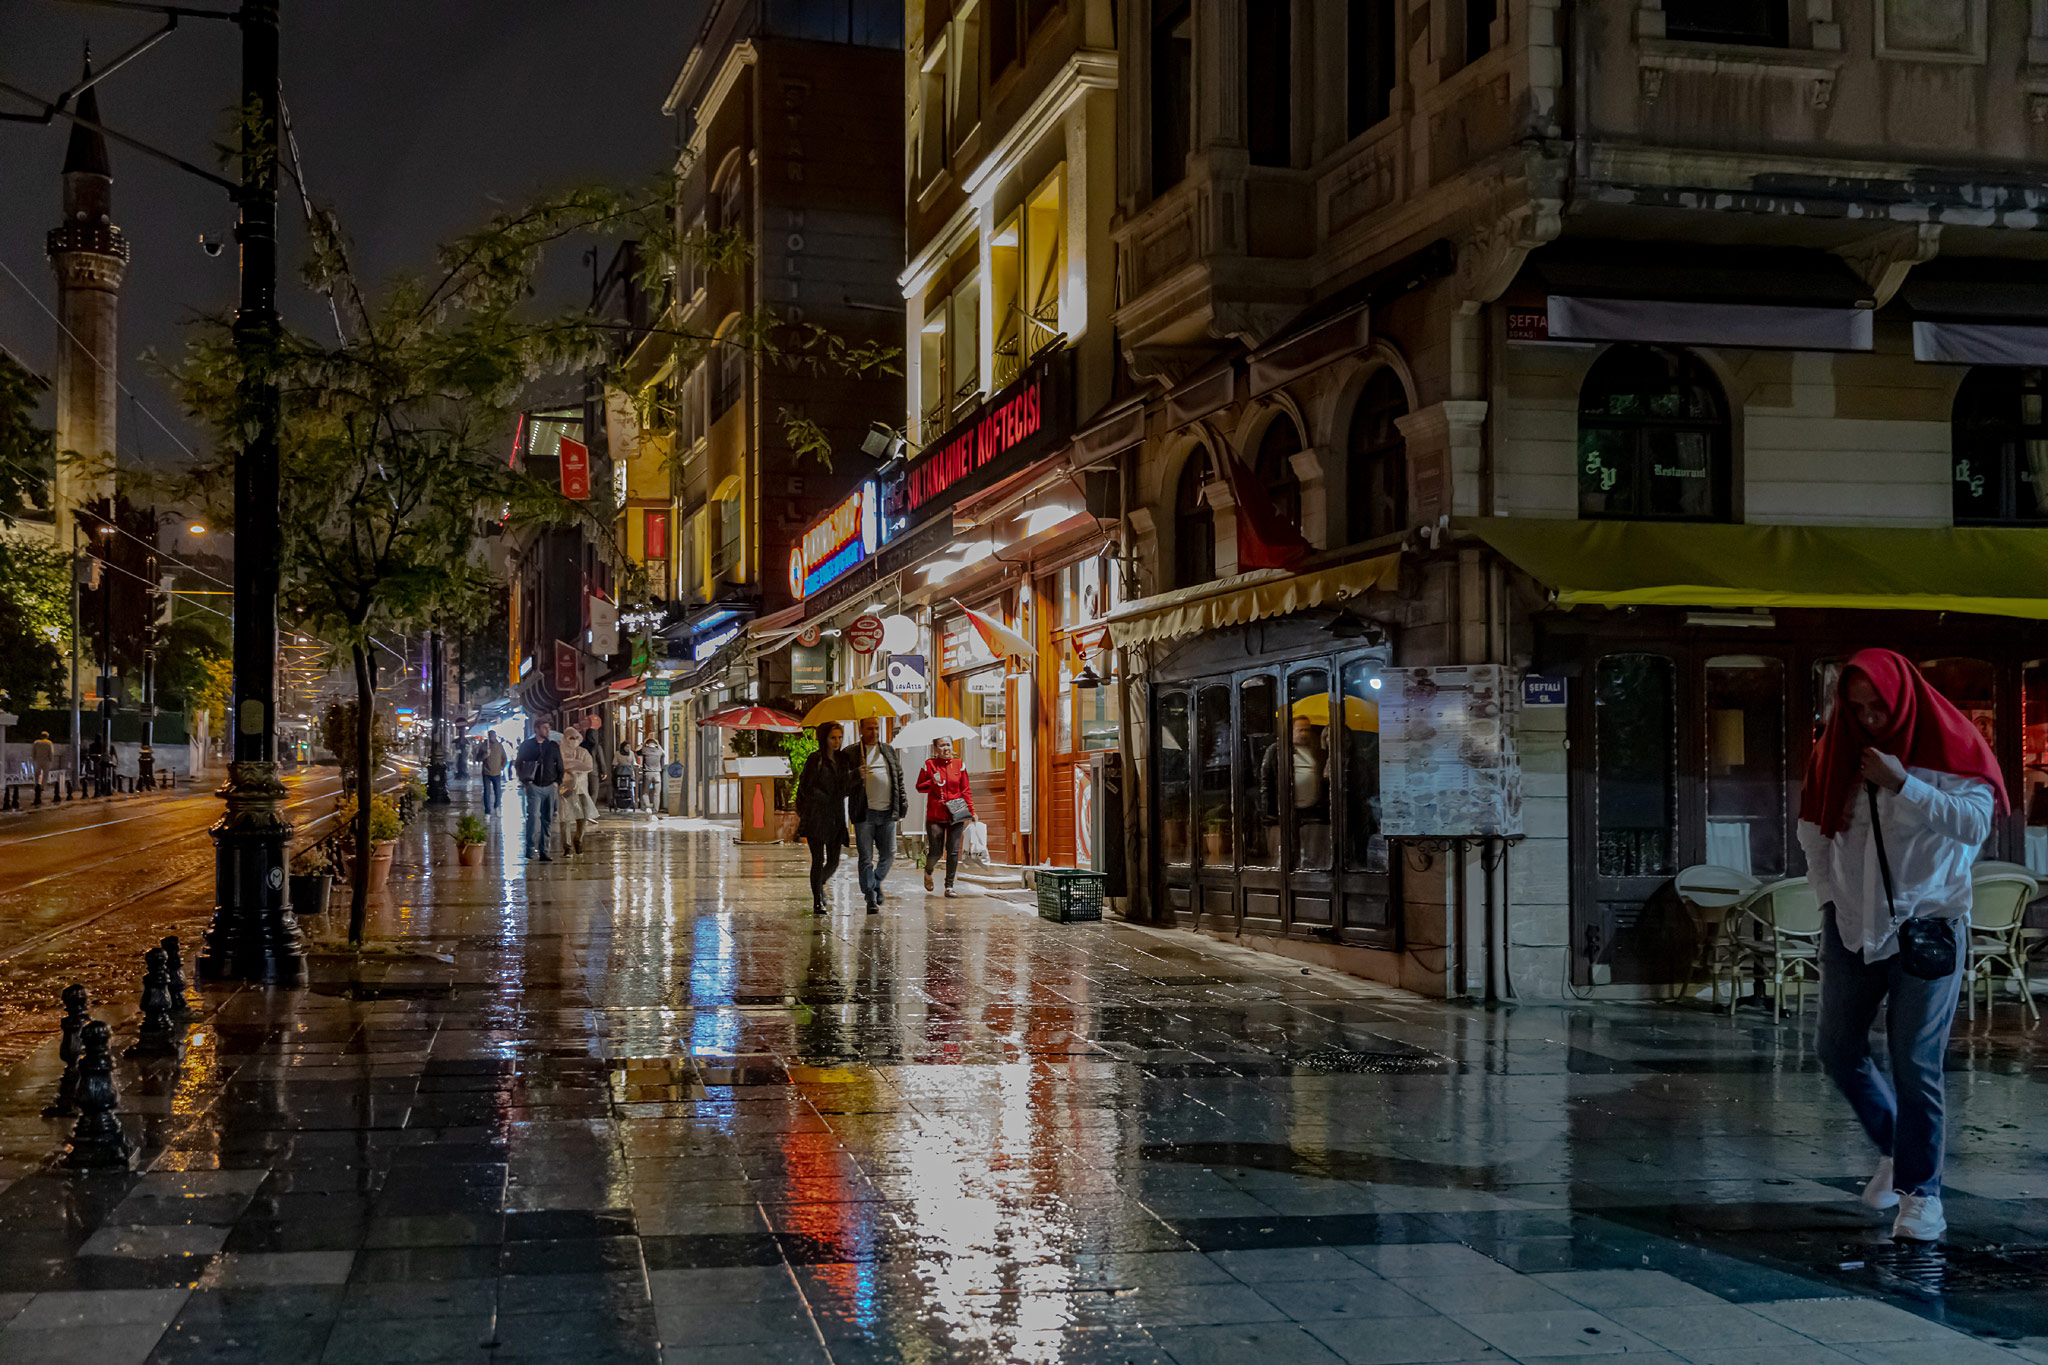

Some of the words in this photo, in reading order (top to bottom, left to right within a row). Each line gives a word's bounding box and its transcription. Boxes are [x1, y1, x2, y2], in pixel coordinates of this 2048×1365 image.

[1508, 314, 1548, 329] ŞEFTA
[907, 429, 974, 513] SULTANAHMET
[1654, 464, 1706, 478] Restaurant
[1529, 681, 1561, 694] ŞEFTALİ
